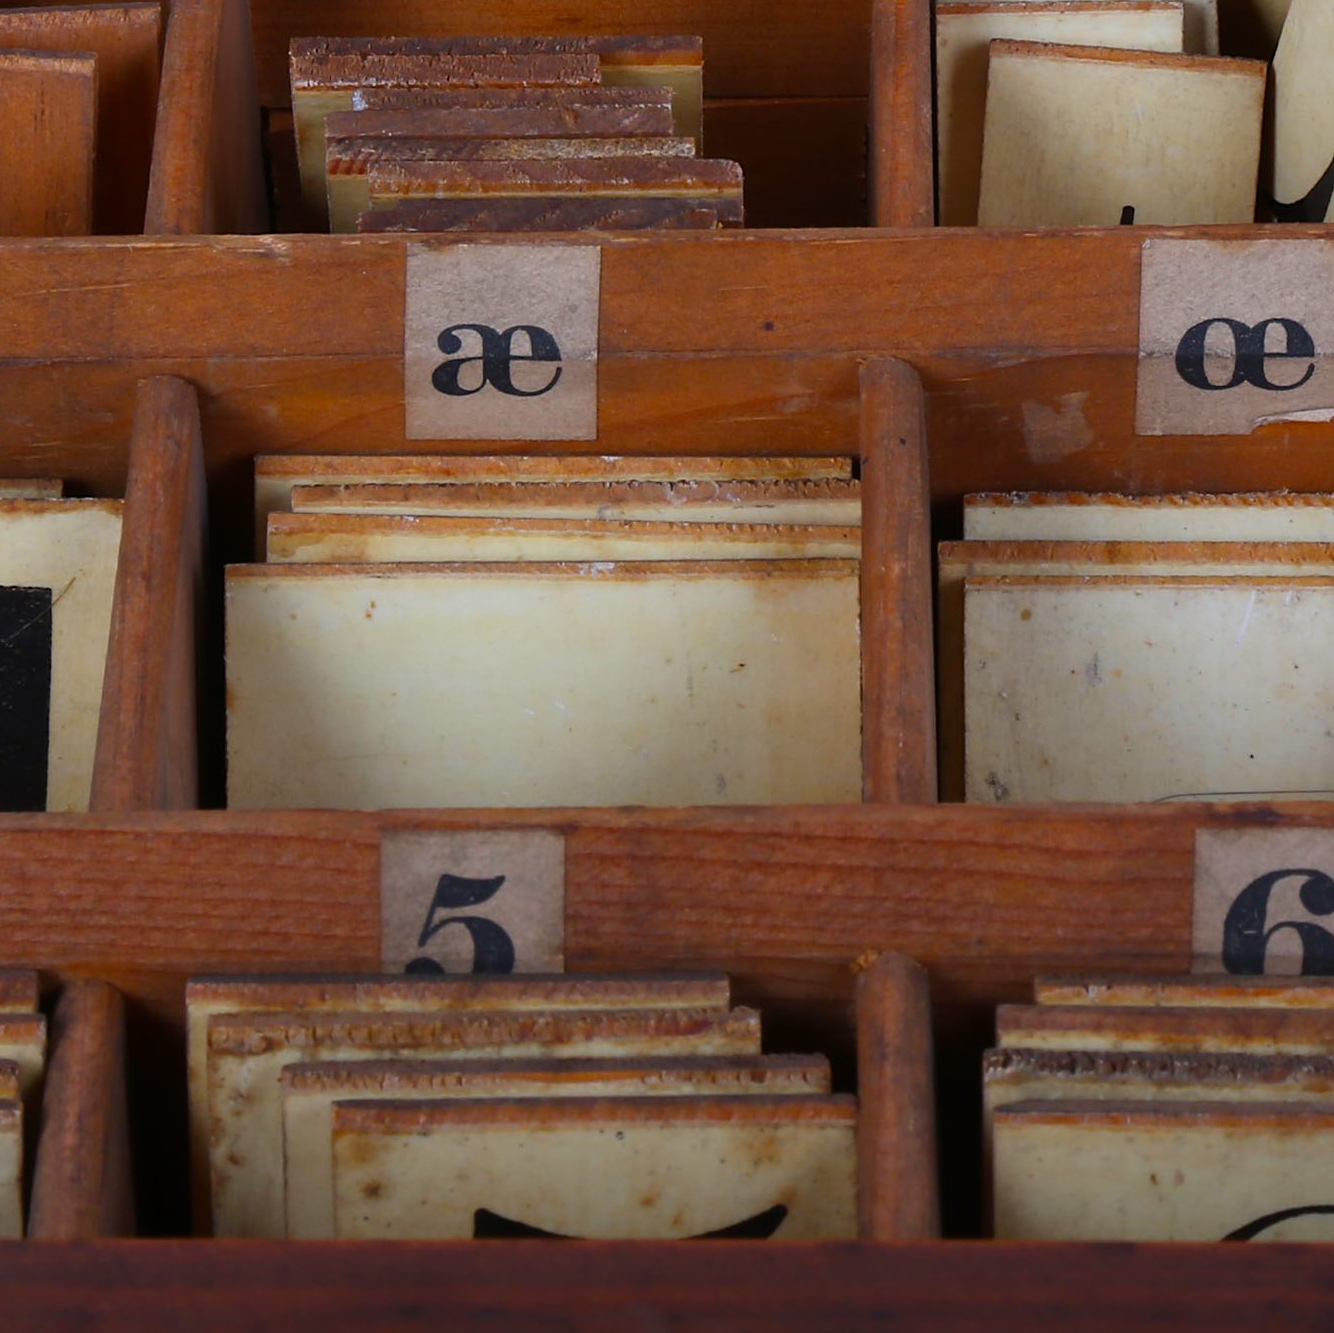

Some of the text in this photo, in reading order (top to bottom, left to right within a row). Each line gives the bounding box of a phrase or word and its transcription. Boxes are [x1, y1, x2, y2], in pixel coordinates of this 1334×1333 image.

[432, 324, 562, 396] æ
[1175, 318, 1315, 390] œ
[405, 874, 515, 973] 5
